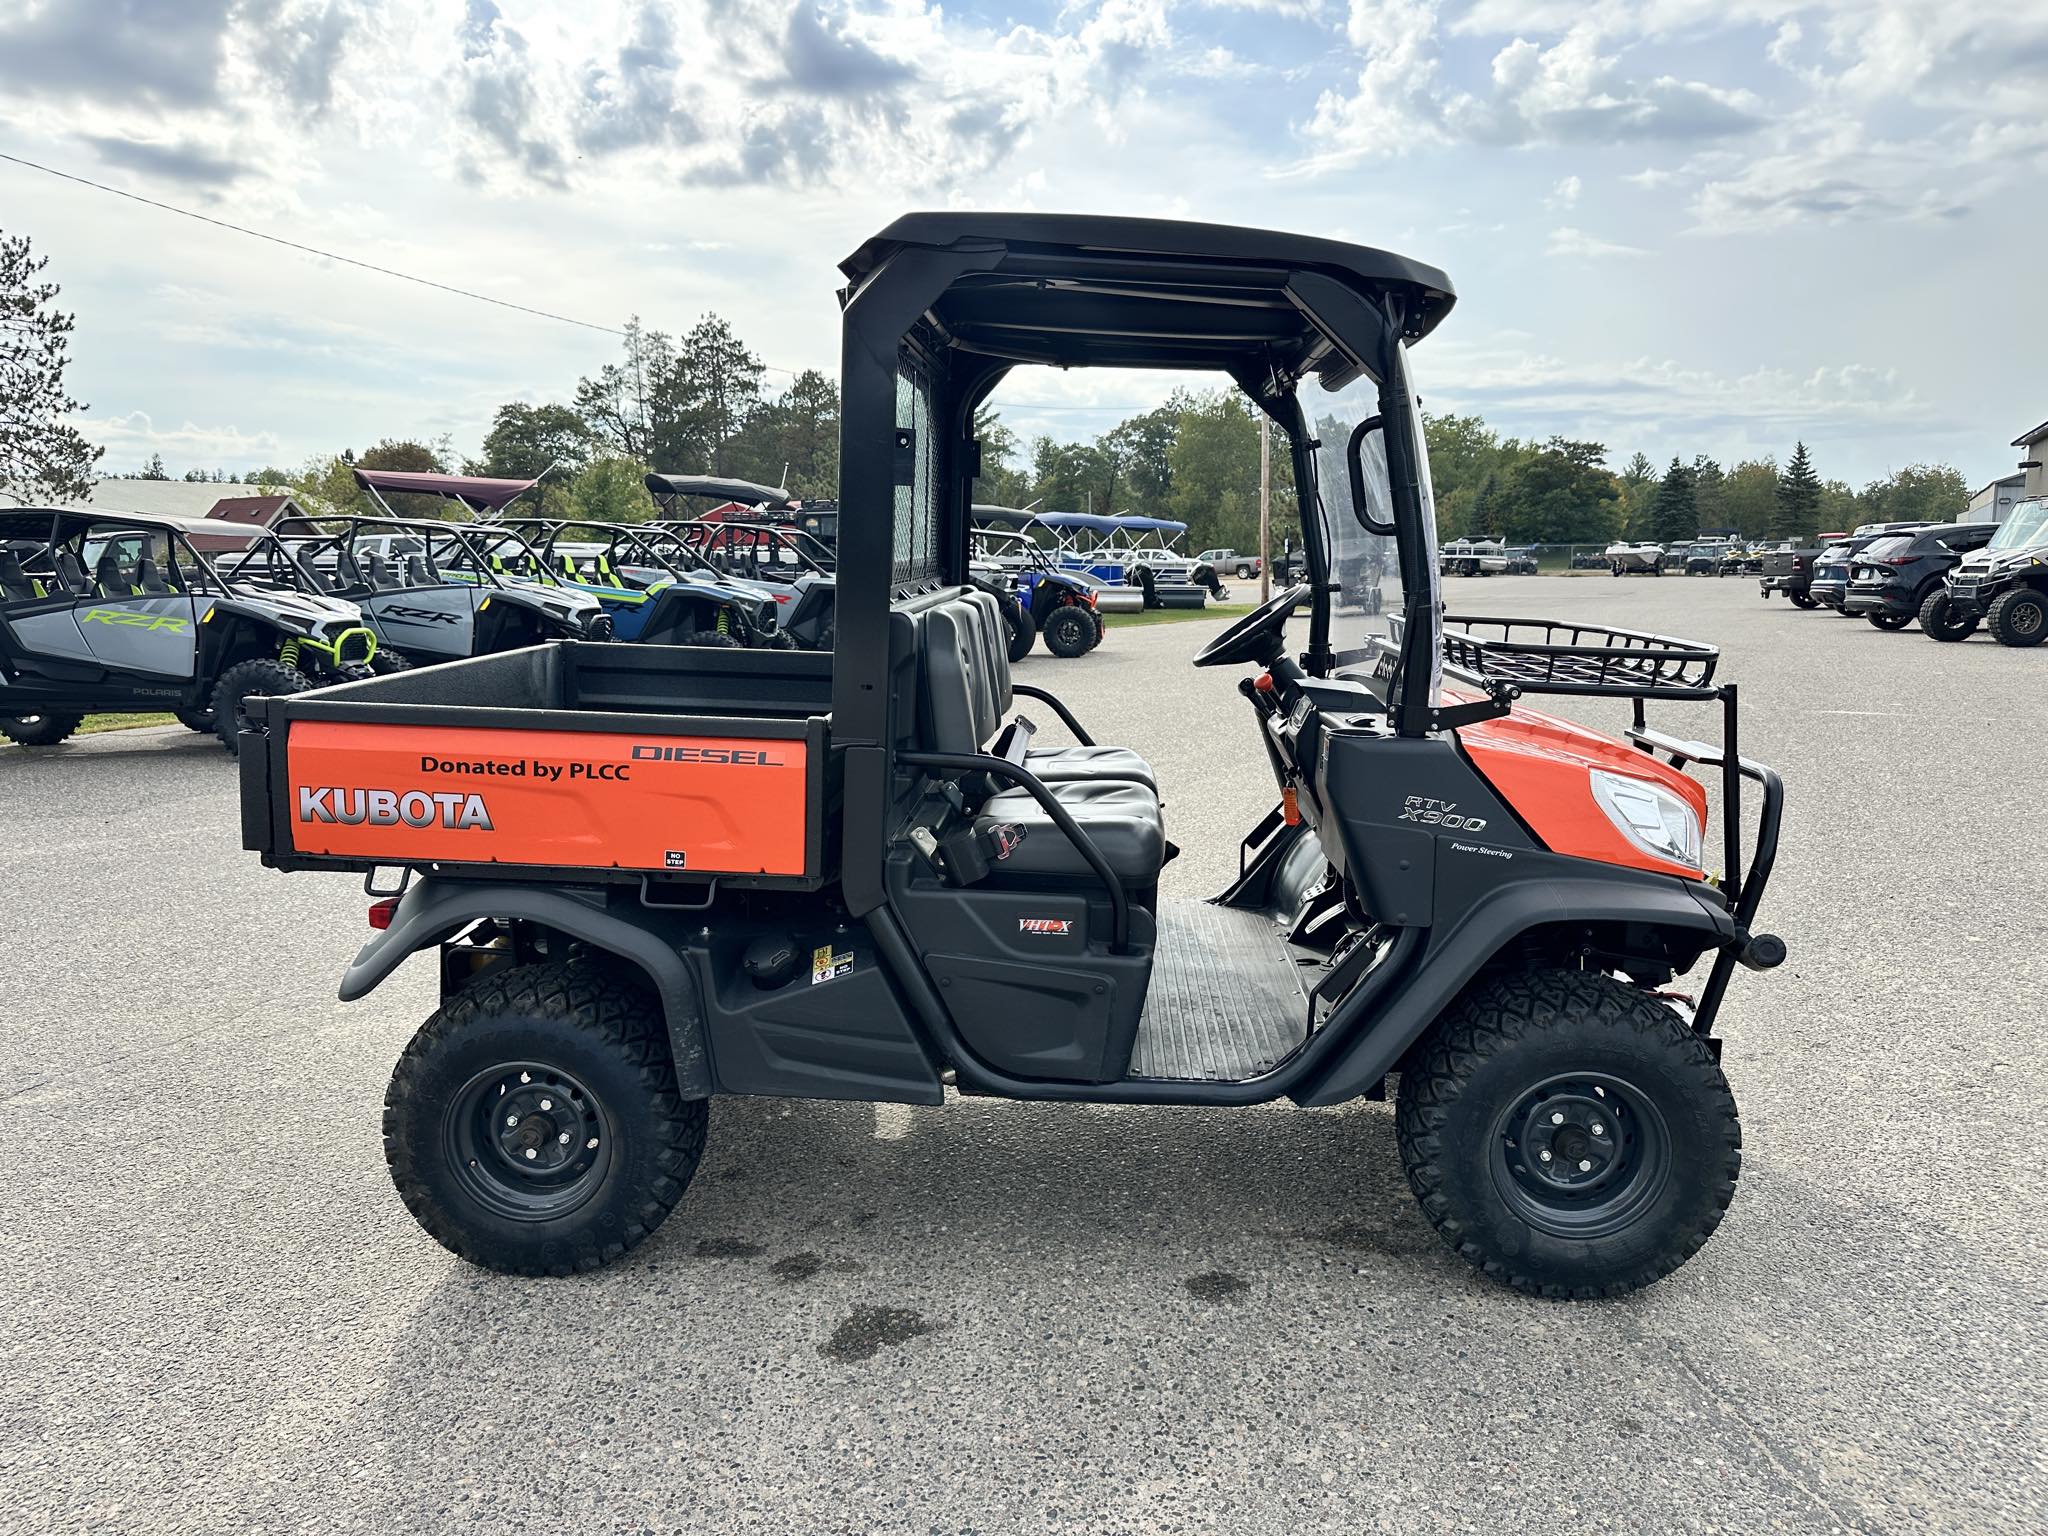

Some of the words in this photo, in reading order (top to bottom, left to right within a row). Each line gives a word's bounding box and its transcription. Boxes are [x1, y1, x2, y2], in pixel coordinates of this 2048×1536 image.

[82, 608, 189, 633] RZR
[379, 604, 463, 625] RZR
[133, 687, 182, 697] POLARIS
[631, 745, 784, 767] DIESEL
[420, 756, 526, 778] Donated
[533, 763, 563, 782] by
[569, 763, 631, 781] PLCC
[299, 786, 494, 831] KUBOTA
[1405, 795, 1457, 813] RTV
[1397, 806, 1487, 832] X900
[1450, 842, 1479, 853] Power
[1478, 846, 1513, 860] Steering
[1018, 918, 1073, 932] VHT-X
